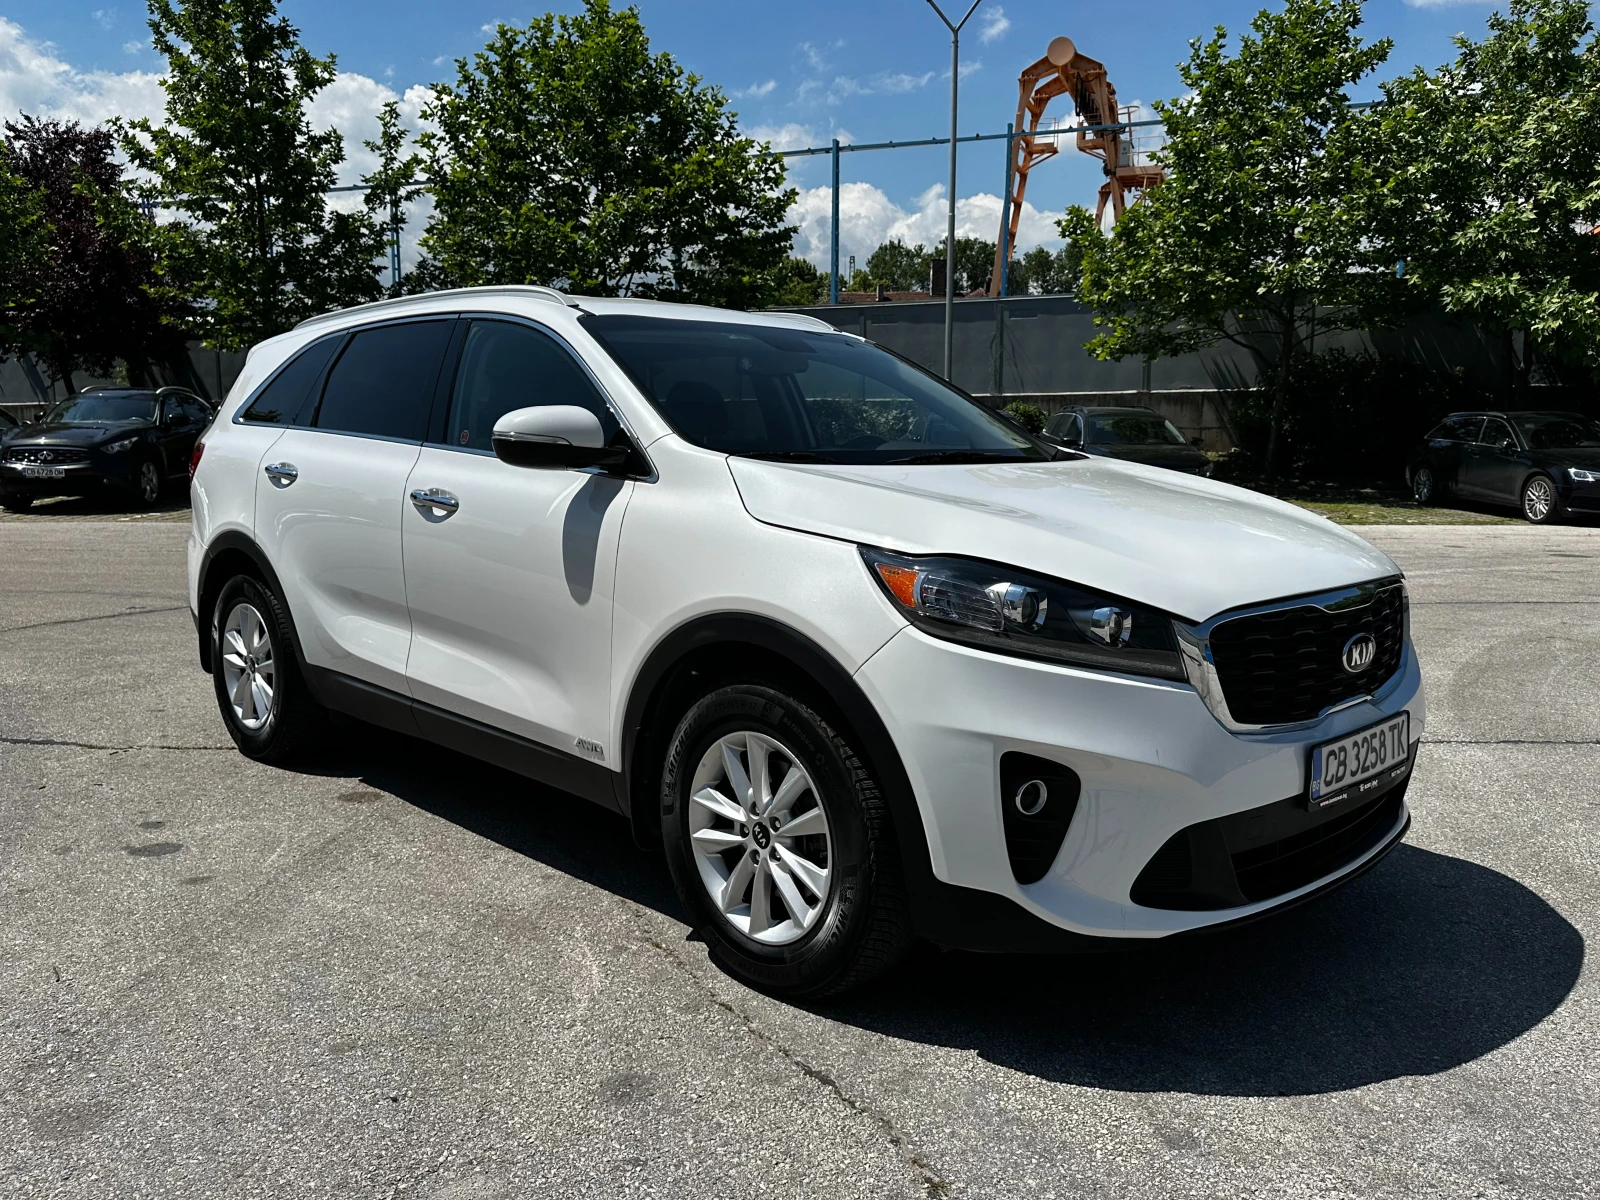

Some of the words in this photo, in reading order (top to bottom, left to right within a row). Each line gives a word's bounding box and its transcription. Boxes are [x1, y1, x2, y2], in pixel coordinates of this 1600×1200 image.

[1350, 641, 1373, 666] KIA
[782, 717, 811, 746] ROTATION
[1324, 745, 1347, 787] CB
[1350, 729, 1387, 777] 3258
[1388, 719, 1405, 760] TK
[754, 824, 766, 847] KIA
